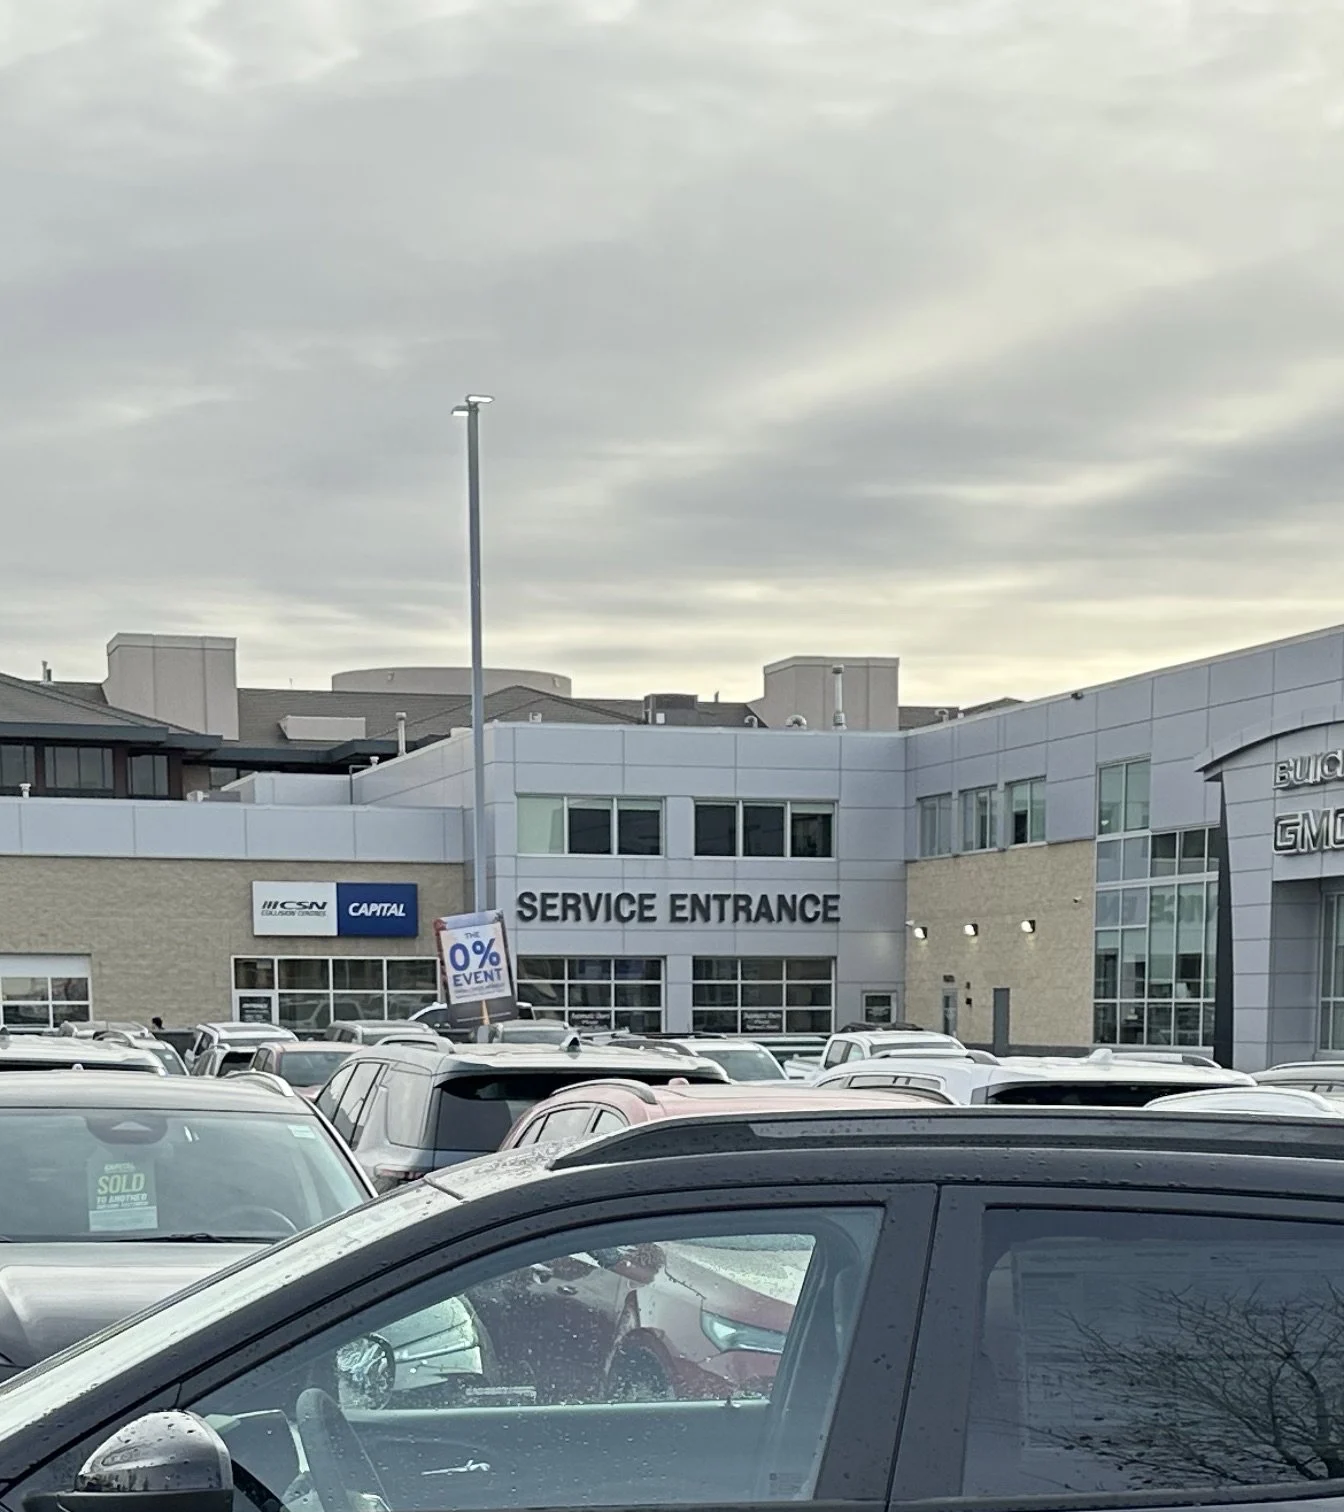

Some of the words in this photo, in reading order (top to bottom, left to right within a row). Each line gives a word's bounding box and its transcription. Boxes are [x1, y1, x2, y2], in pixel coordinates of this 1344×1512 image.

[348, 902, 406, 917] CAPITAL
[516, 891, 657, 924] SERVICE
[669, 893, 841, 924] ENTRANCE
[465, 931, 481, 939] THE
[449, 938, 501, 971] 0%
[452, 968, 502, 987] EVENT
[97, 1172, 146, 1195] SOLD
